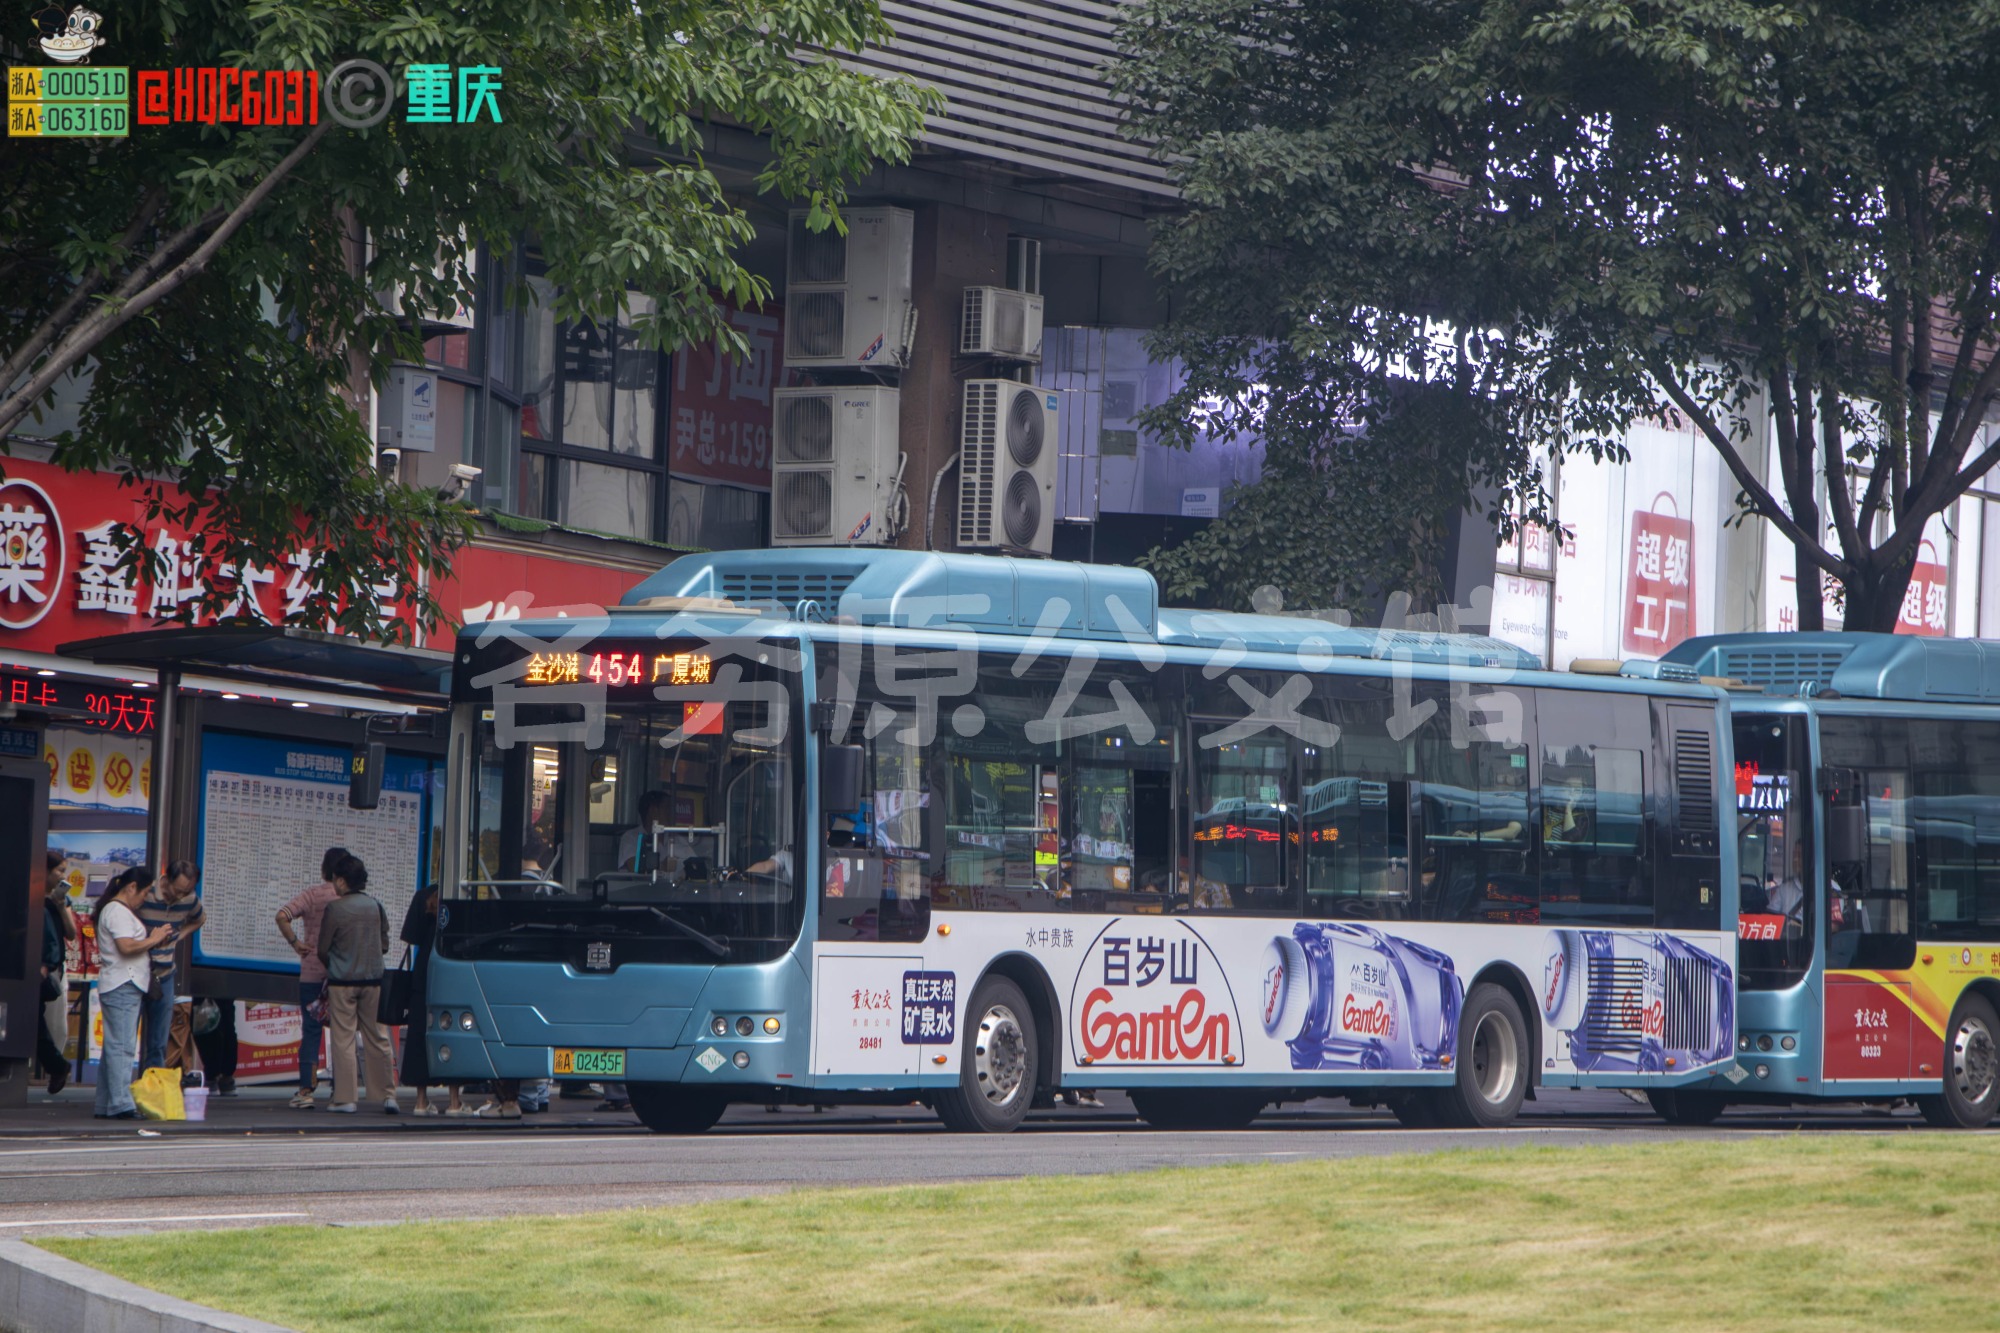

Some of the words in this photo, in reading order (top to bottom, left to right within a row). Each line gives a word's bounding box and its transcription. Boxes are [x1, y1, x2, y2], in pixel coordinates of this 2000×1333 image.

[676, 308, 796, 407] 门面
[1635, 529, 1689, 588] 超级
[1502, 617, 1531, 635] Eyewear
[1531, 623, 1569, 641] Suptore
[1633, 594, 1687, 644] 工厂
[588, 653, 642, 685] 454
[651, 653, 710, 685] 广厦城
[0, 677, 58, 708] 日卡
[70, 752, 93, 791] 送
[103, 756, 133, 793] 69
[1025, 927, 1074, 949] 水中贵族
[1103, 936, 1199, 988] 百岁山
[1363, 963, 1387, 988] 百岁山
[851, 989, 892, 1010] 重庆公交
[904, 978, 954, 1002] 真正天然
[903, 1006, 953, 1037] 矿泉水
[859, 1036, 883, 1049] 28481
[700, 1053, 721, 1067] CNG
